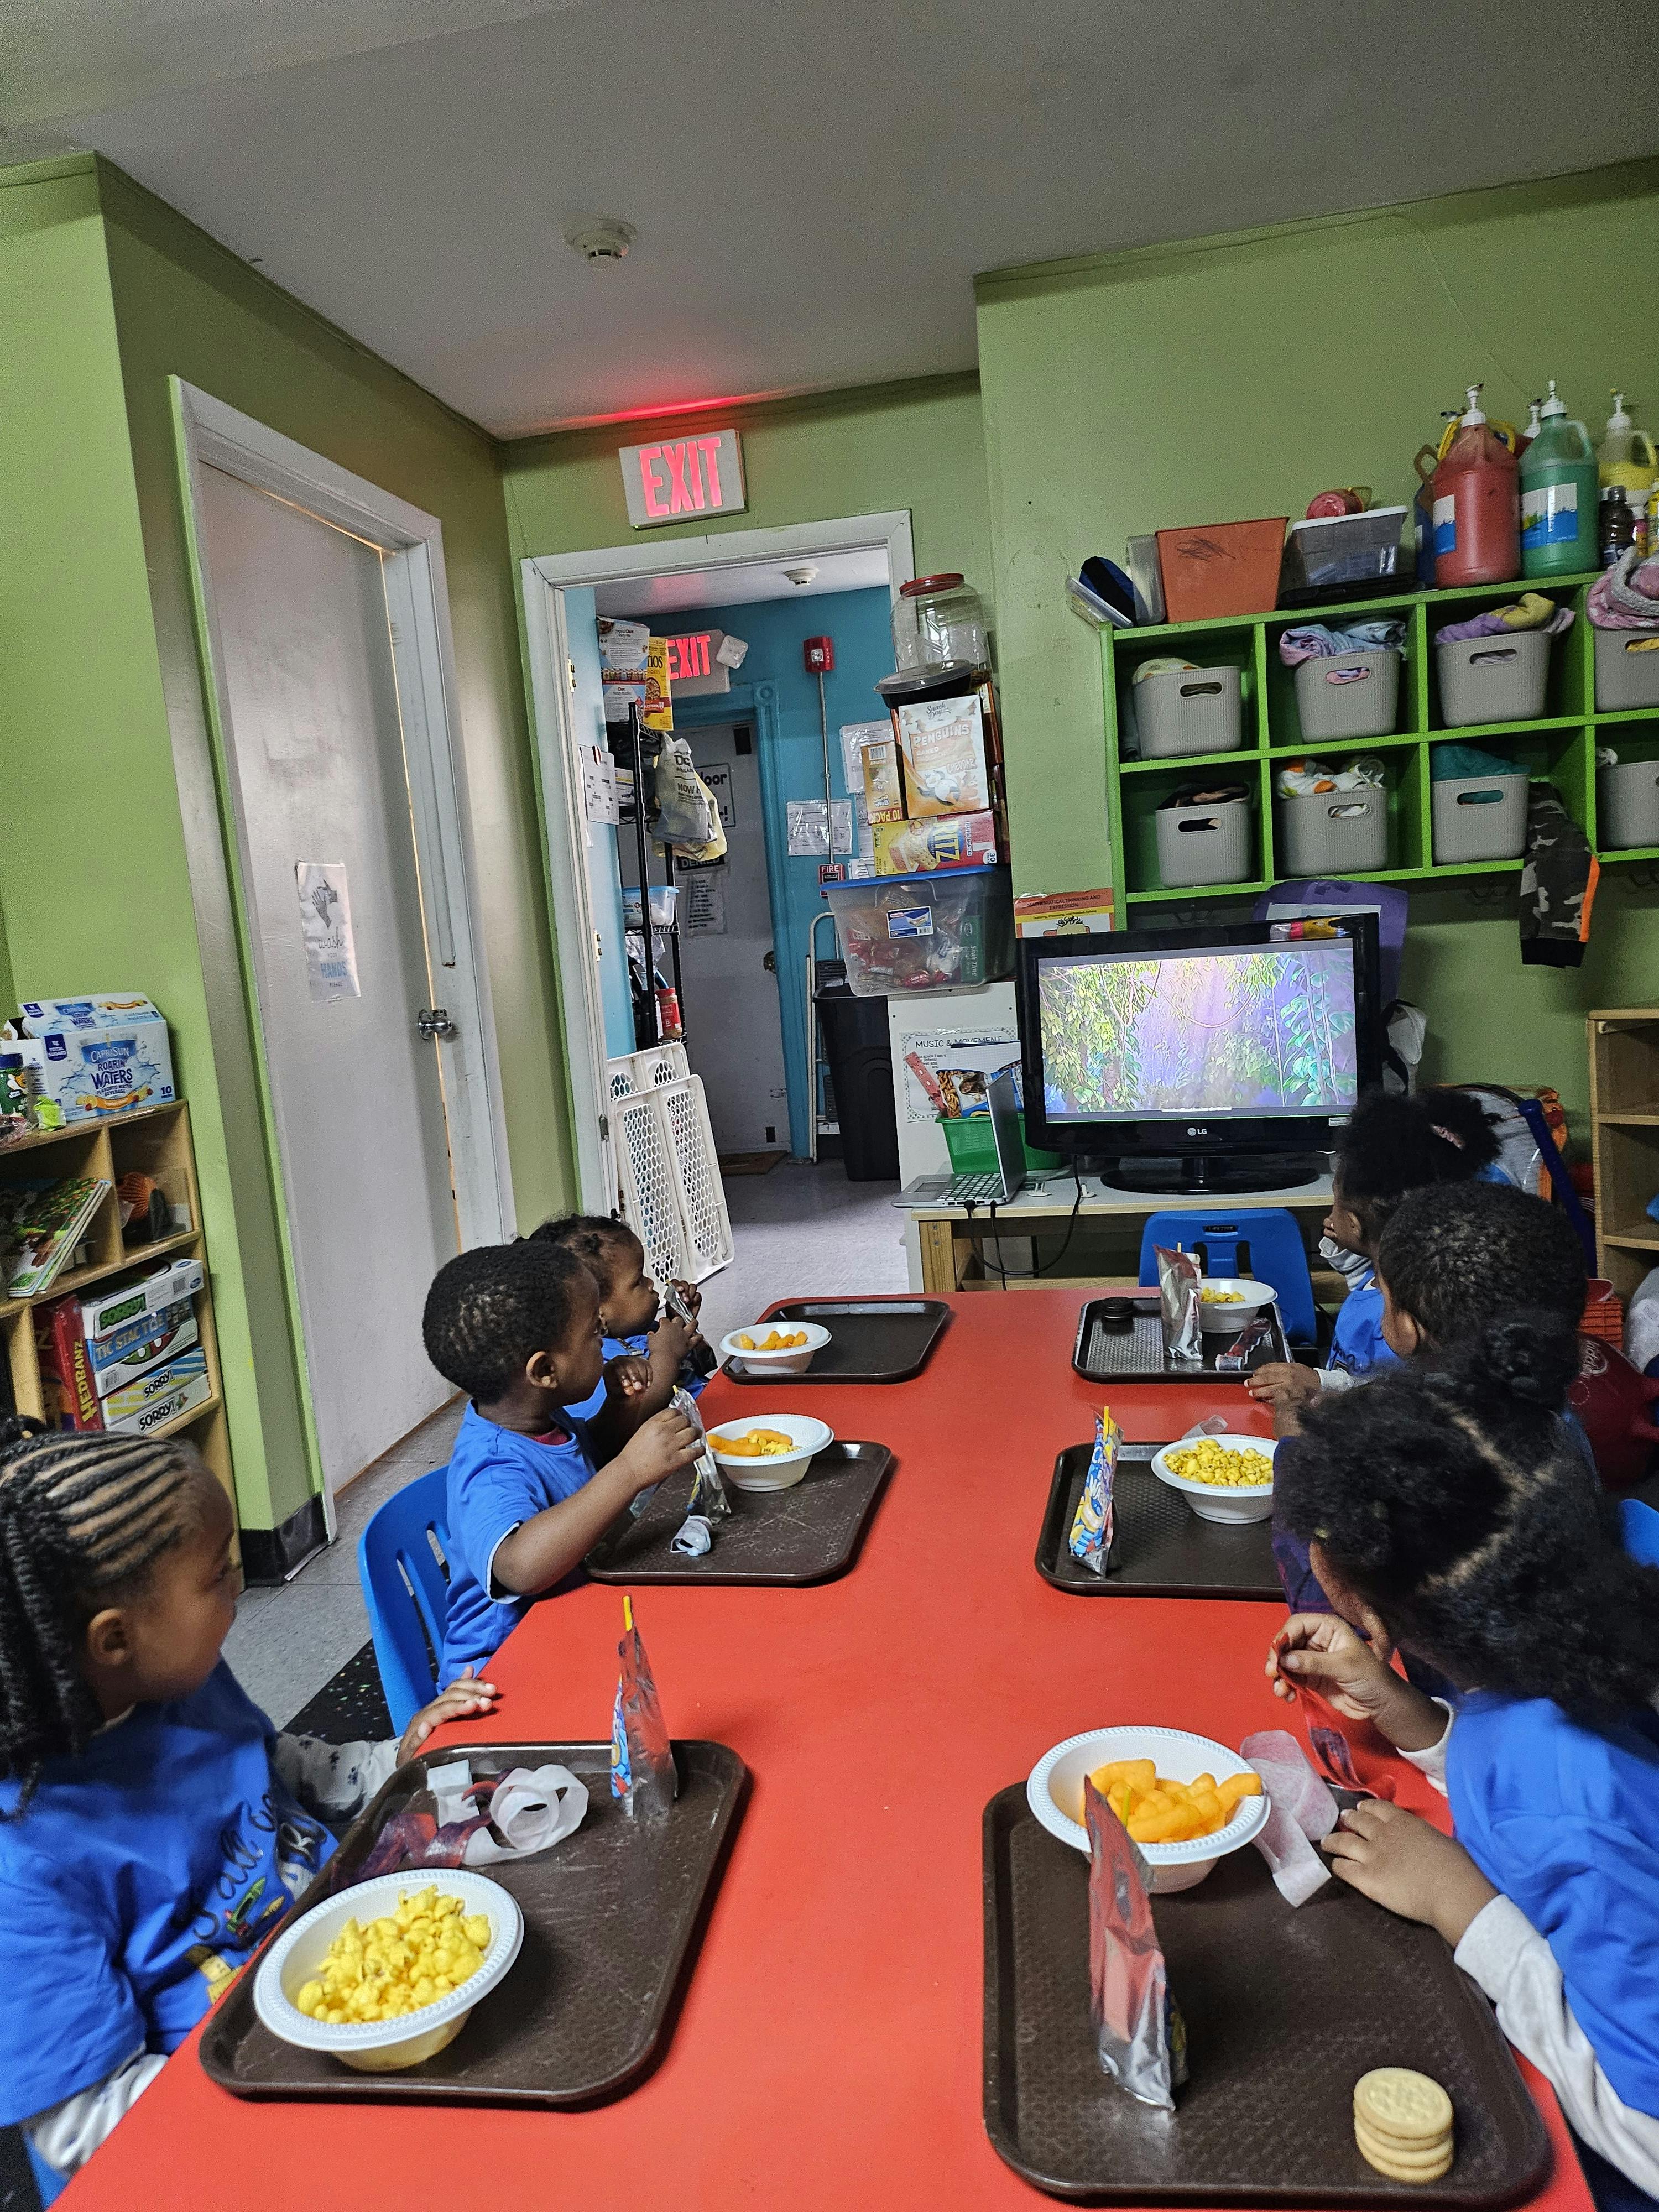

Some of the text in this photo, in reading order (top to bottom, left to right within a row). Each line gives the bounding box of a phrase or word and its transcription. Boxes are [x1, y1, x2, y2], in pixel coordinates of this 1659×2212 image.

[639, 437, 723, 518] EXIT
[667, 635, 711, 680] EXIT
[926, 702, 946, 714] Snack
[928, 708, 943, 719] Day
[914, 724, 971, 747] PENGUINS
[947, 759, 977, 774] CHEDDAR
[700, 772, 727, 786] oor
[677, 783, 695, 794] NOW
[869, 813, 891, 823] PACK
[933, 820, 961, 863] RITZ
[989, 853, 996, 863] 30
[318, 926, 343, 950] wash
[320, 961, 348, 978] HANDS
[916, 1040, 944, 1048] MUSIC
[90, 1069, 133, 1090] WATERS
[160, 1086, 172, 1094] 10
[144, 1366, 175, 1399] SORRY!
[139, 1397, 176, 1431] SORRY!
